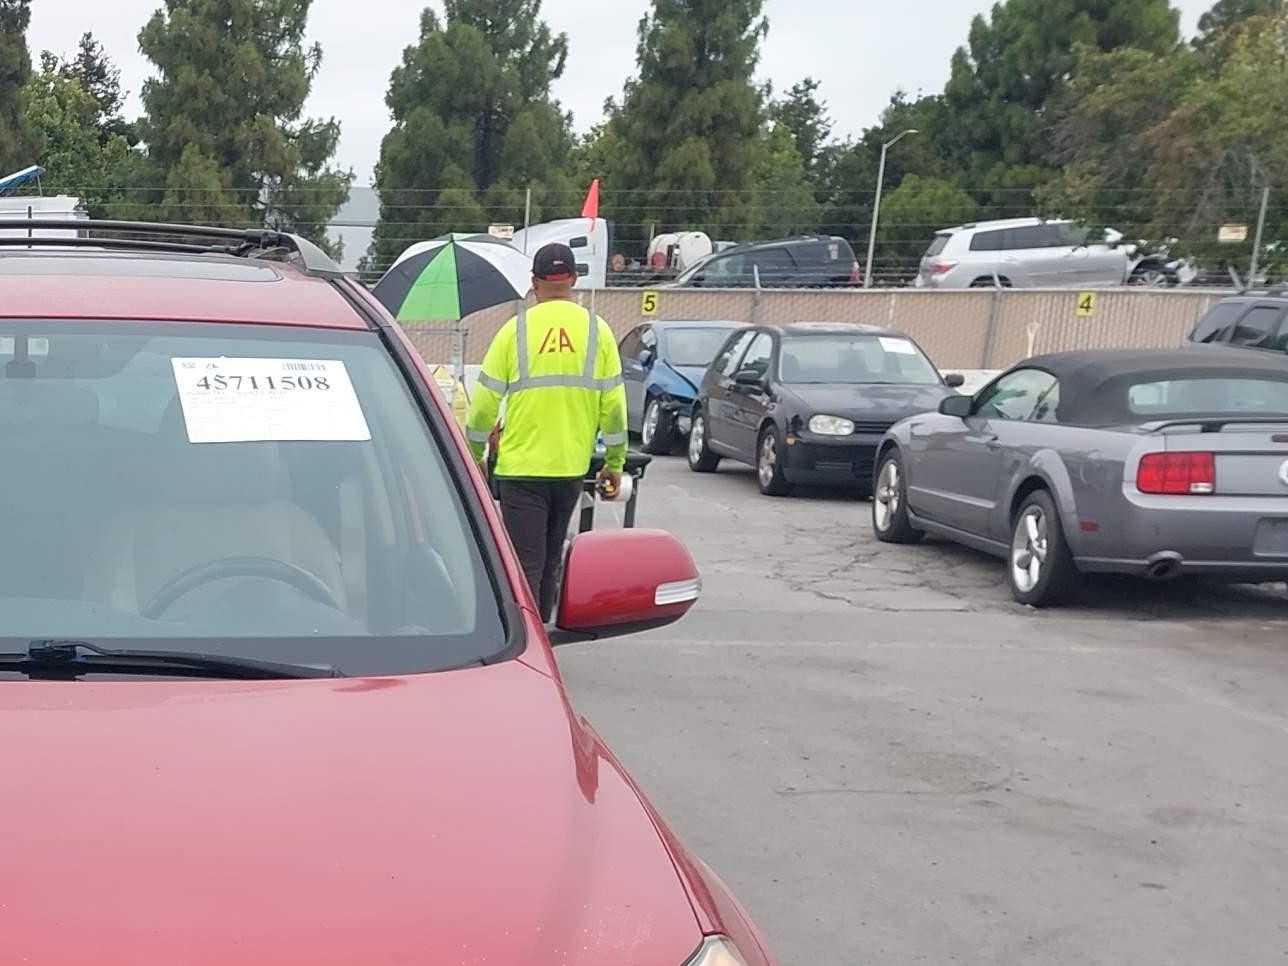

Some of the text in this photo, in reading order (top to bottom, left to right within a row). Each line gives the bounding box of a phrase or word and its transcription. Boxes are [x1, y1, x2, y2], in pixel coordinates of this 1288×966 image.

[643, 294, 656, 313] 5
[1079, 294, 1093, 314] 4
[196, 374, 331, 391] 45711508
